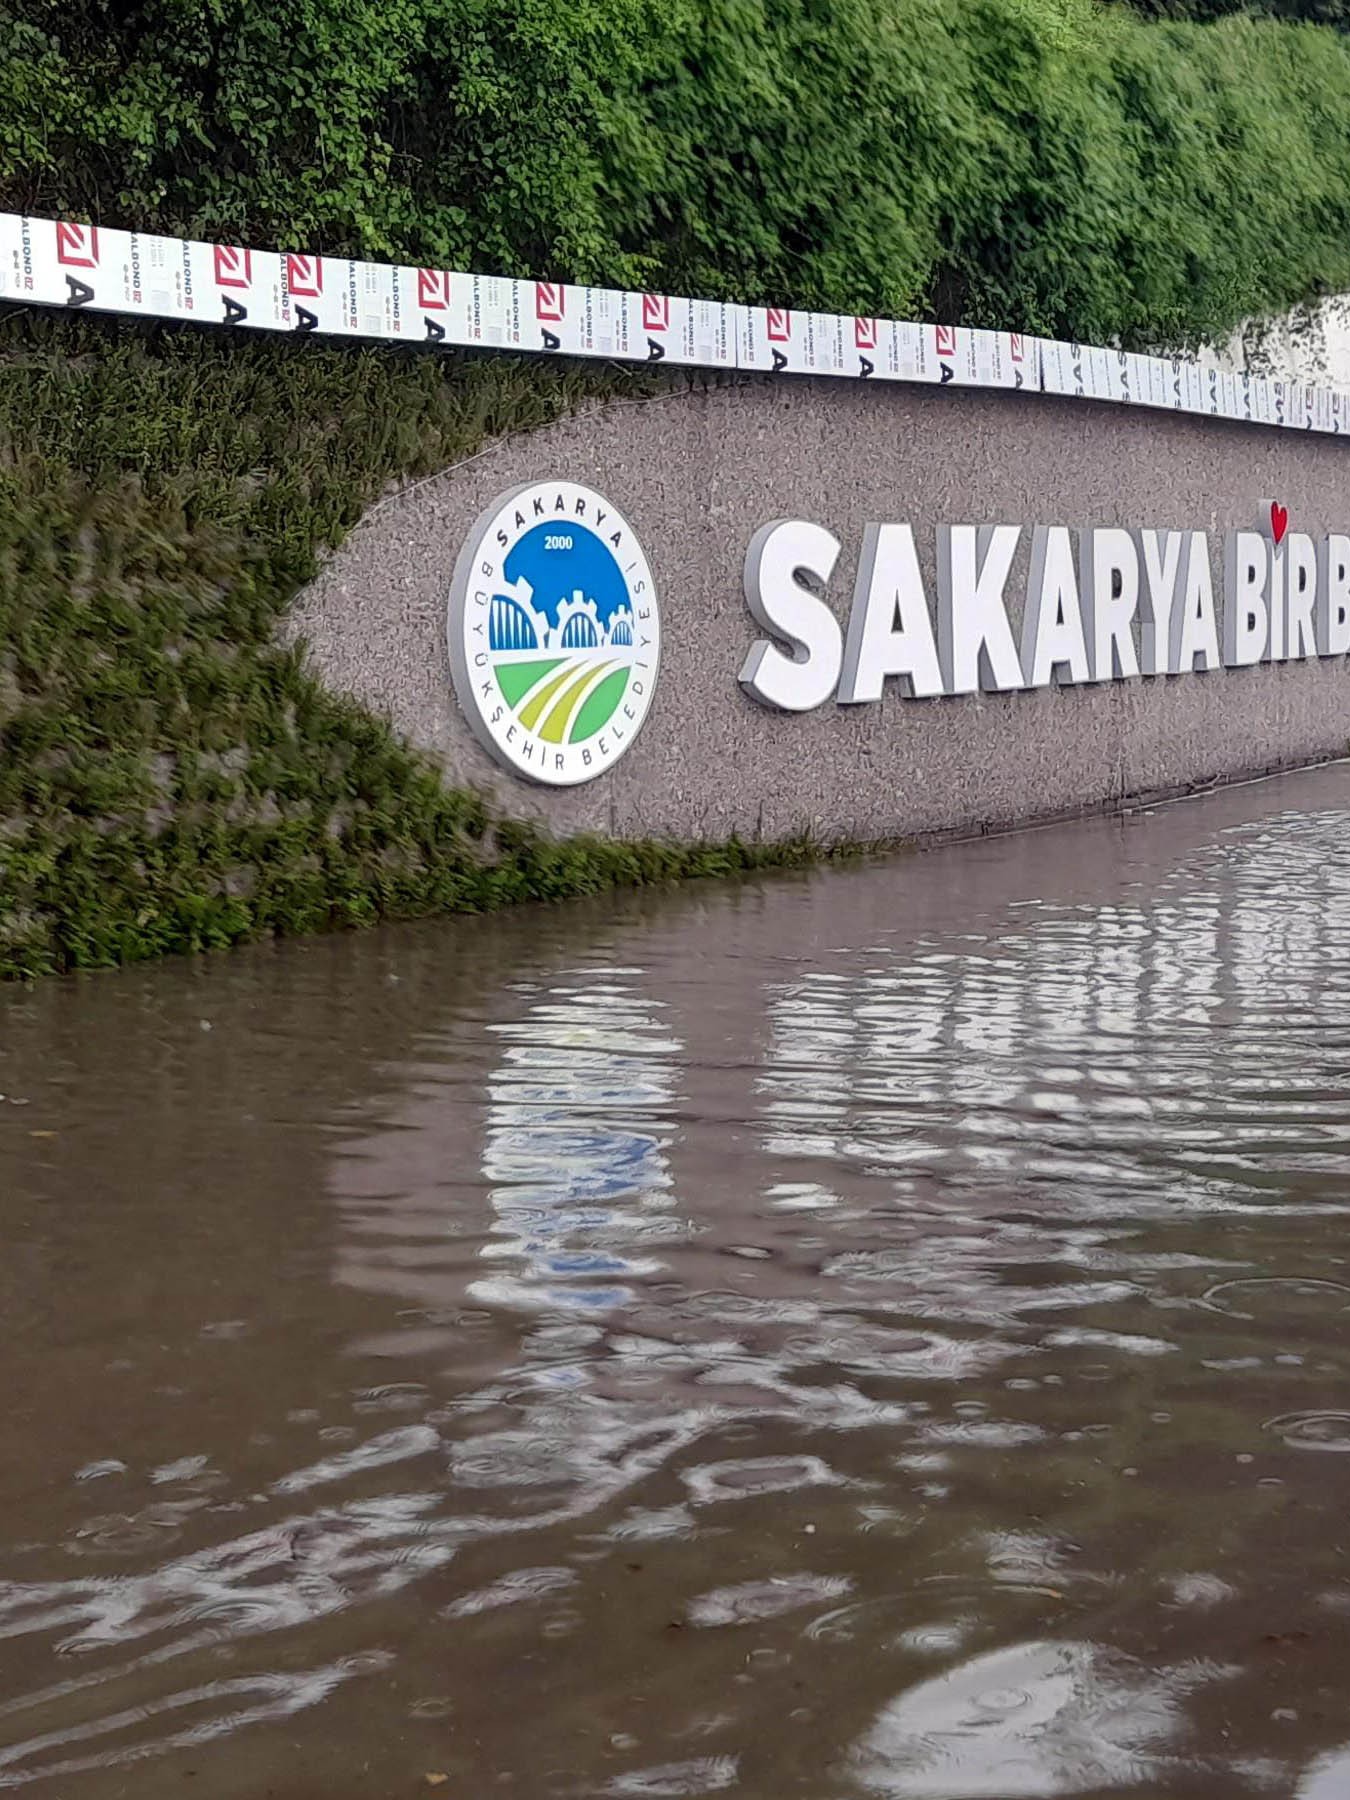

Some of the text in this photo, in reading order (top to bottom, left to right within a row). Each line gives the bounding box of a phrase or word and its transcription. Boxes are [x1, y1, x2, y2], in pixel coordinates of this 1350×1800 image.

[497, 494, 621, 548] SAKARYA
[544, 536, 573, 550] 2000
[738, 519, 1221, 711] SAKARYA
[473, 561, 564, 770] BÜYÜKŞEHİR
[583, 561, 651, 766] BELEDİYESİ
